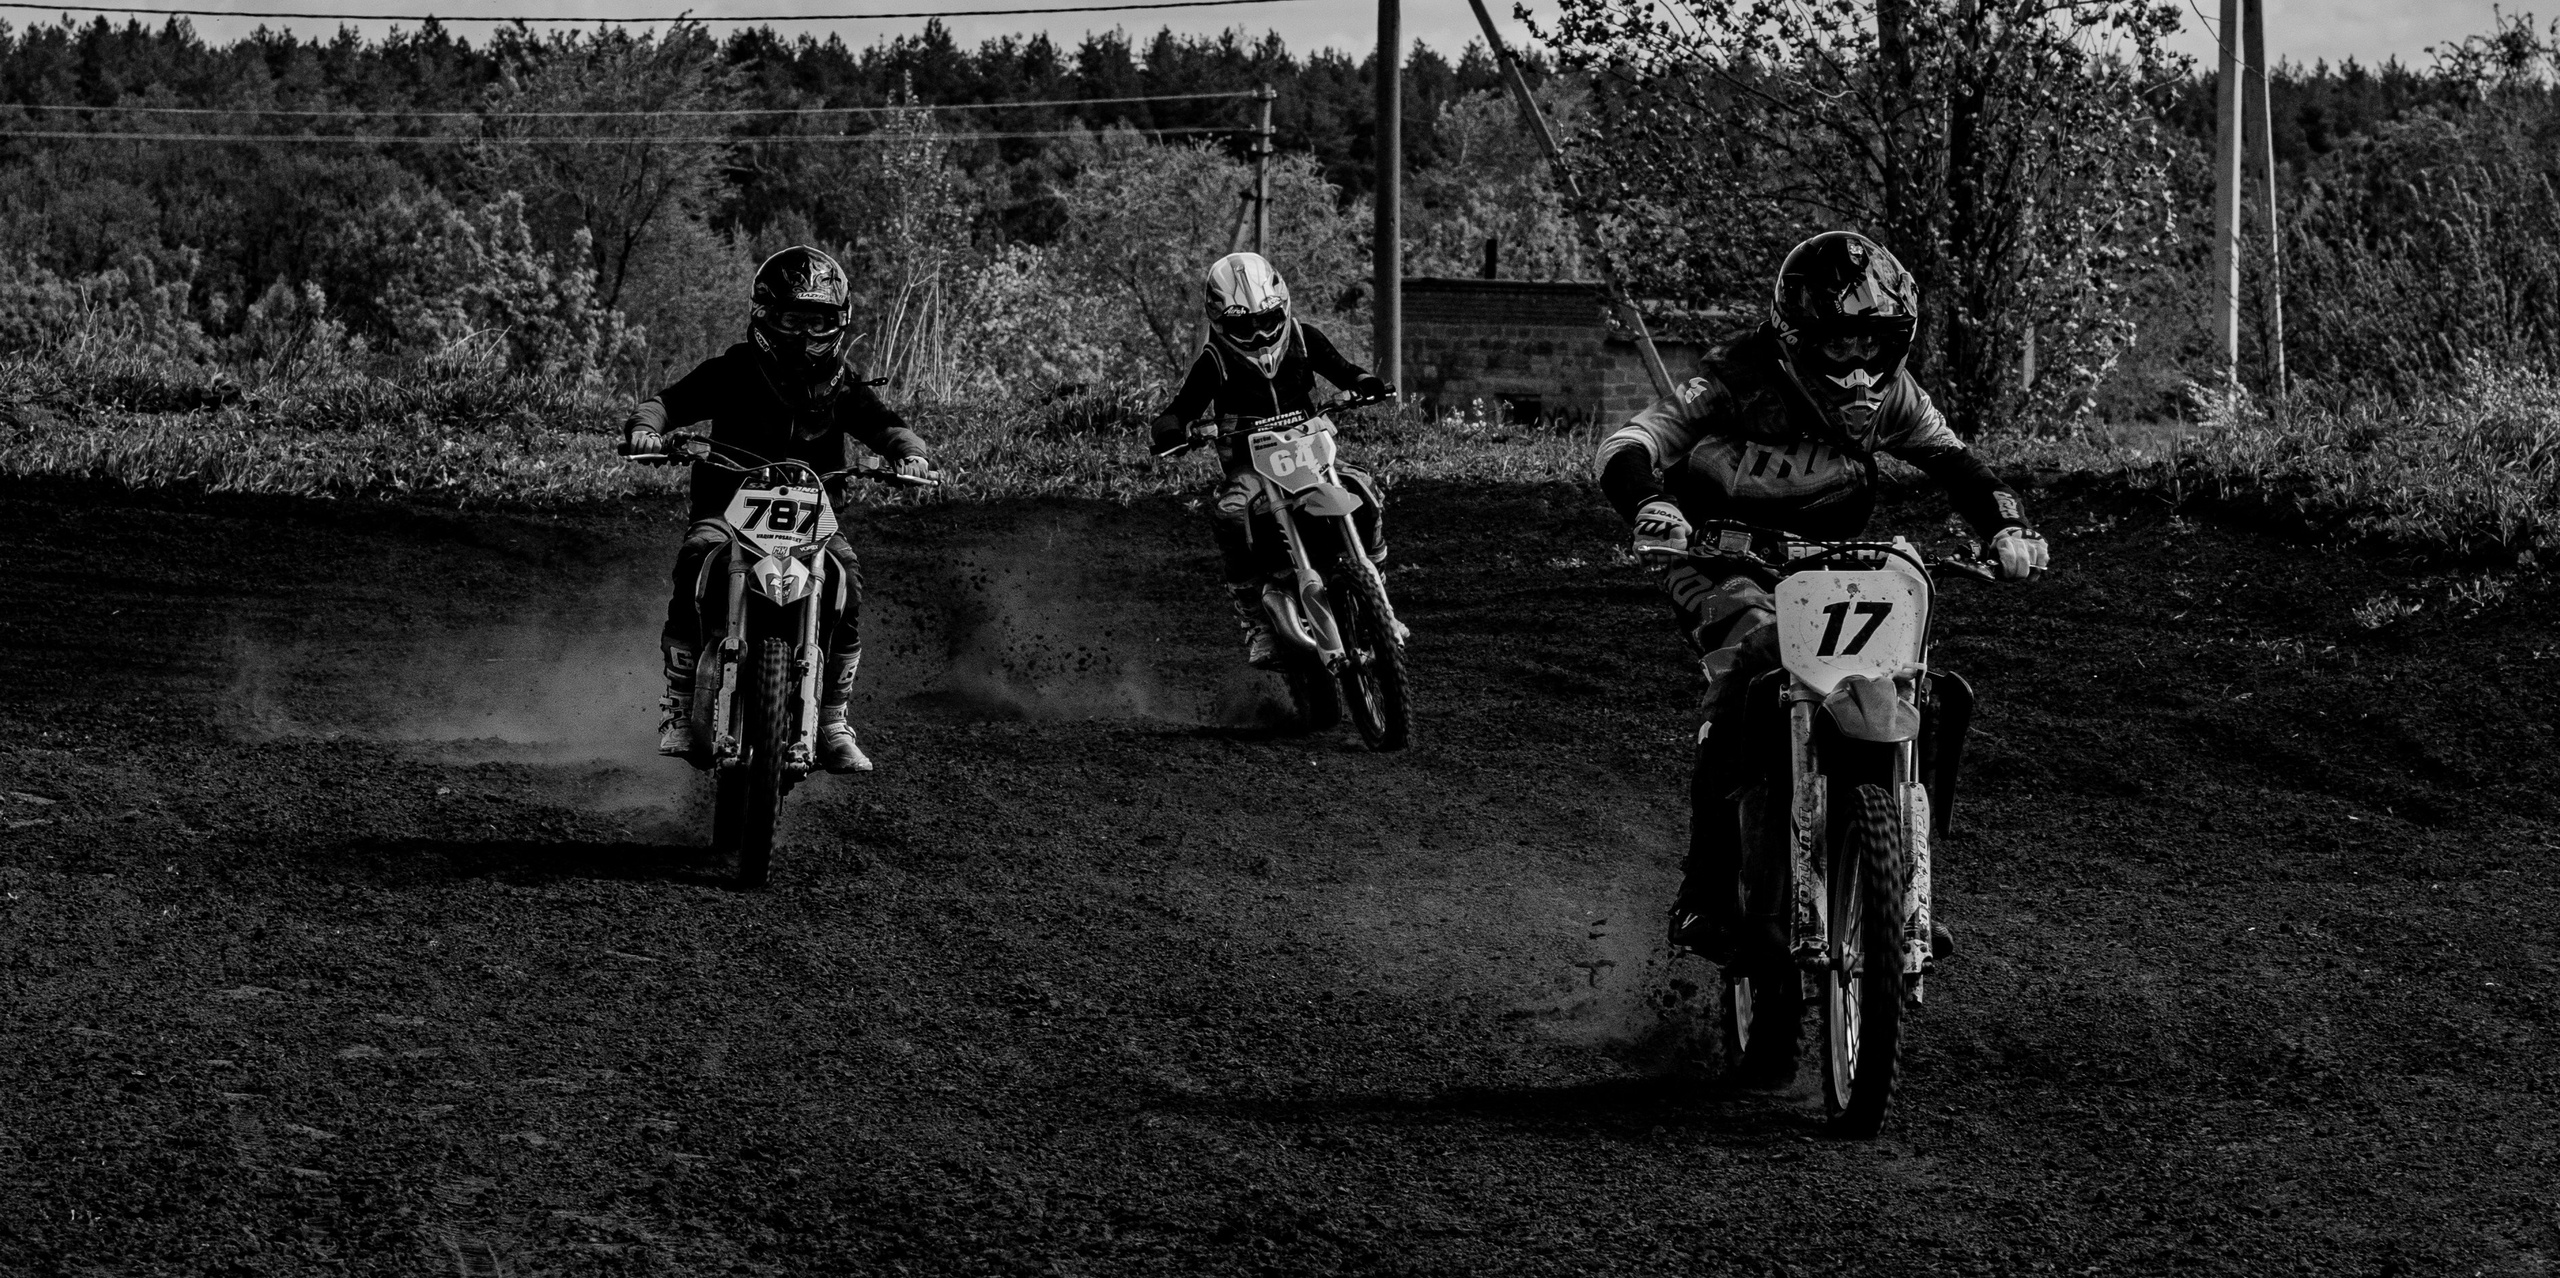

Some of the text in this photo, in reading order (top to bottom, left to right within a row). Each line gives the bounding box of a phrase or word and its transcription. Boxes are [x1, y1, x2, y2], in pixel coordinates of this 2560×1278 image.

[1269, 442, 1316, 477] 64
[741, 497, 825, 535] 787
[1816, 602, 1893, 657] 17
[1798, 806, 1812, 925] DUNLOP
[1916, 815, 1930, 927] DUNLOP
